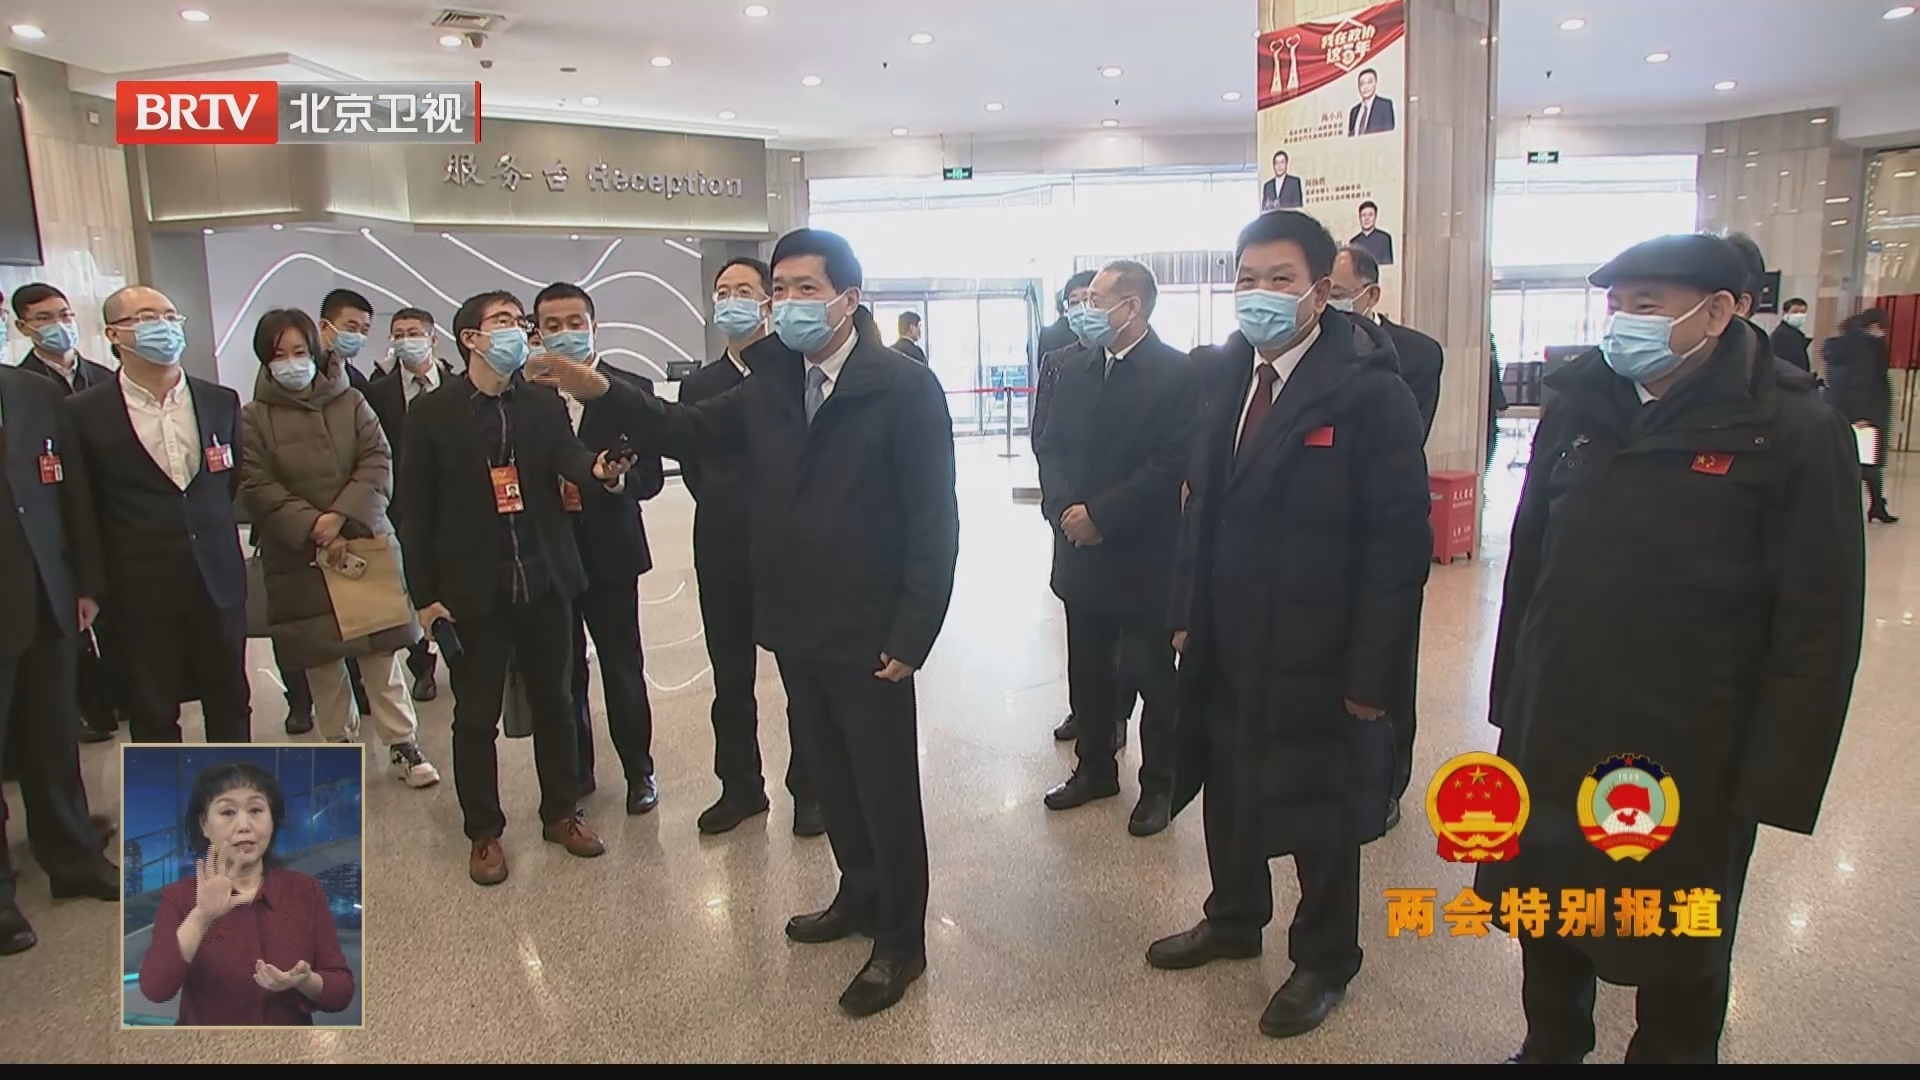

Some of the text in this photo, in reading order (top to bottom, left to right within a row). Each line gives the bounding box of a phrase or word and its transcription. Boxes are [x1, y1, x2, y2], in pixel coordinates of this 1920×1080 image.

[443, 152, 743, 199] 服务台 Reception
